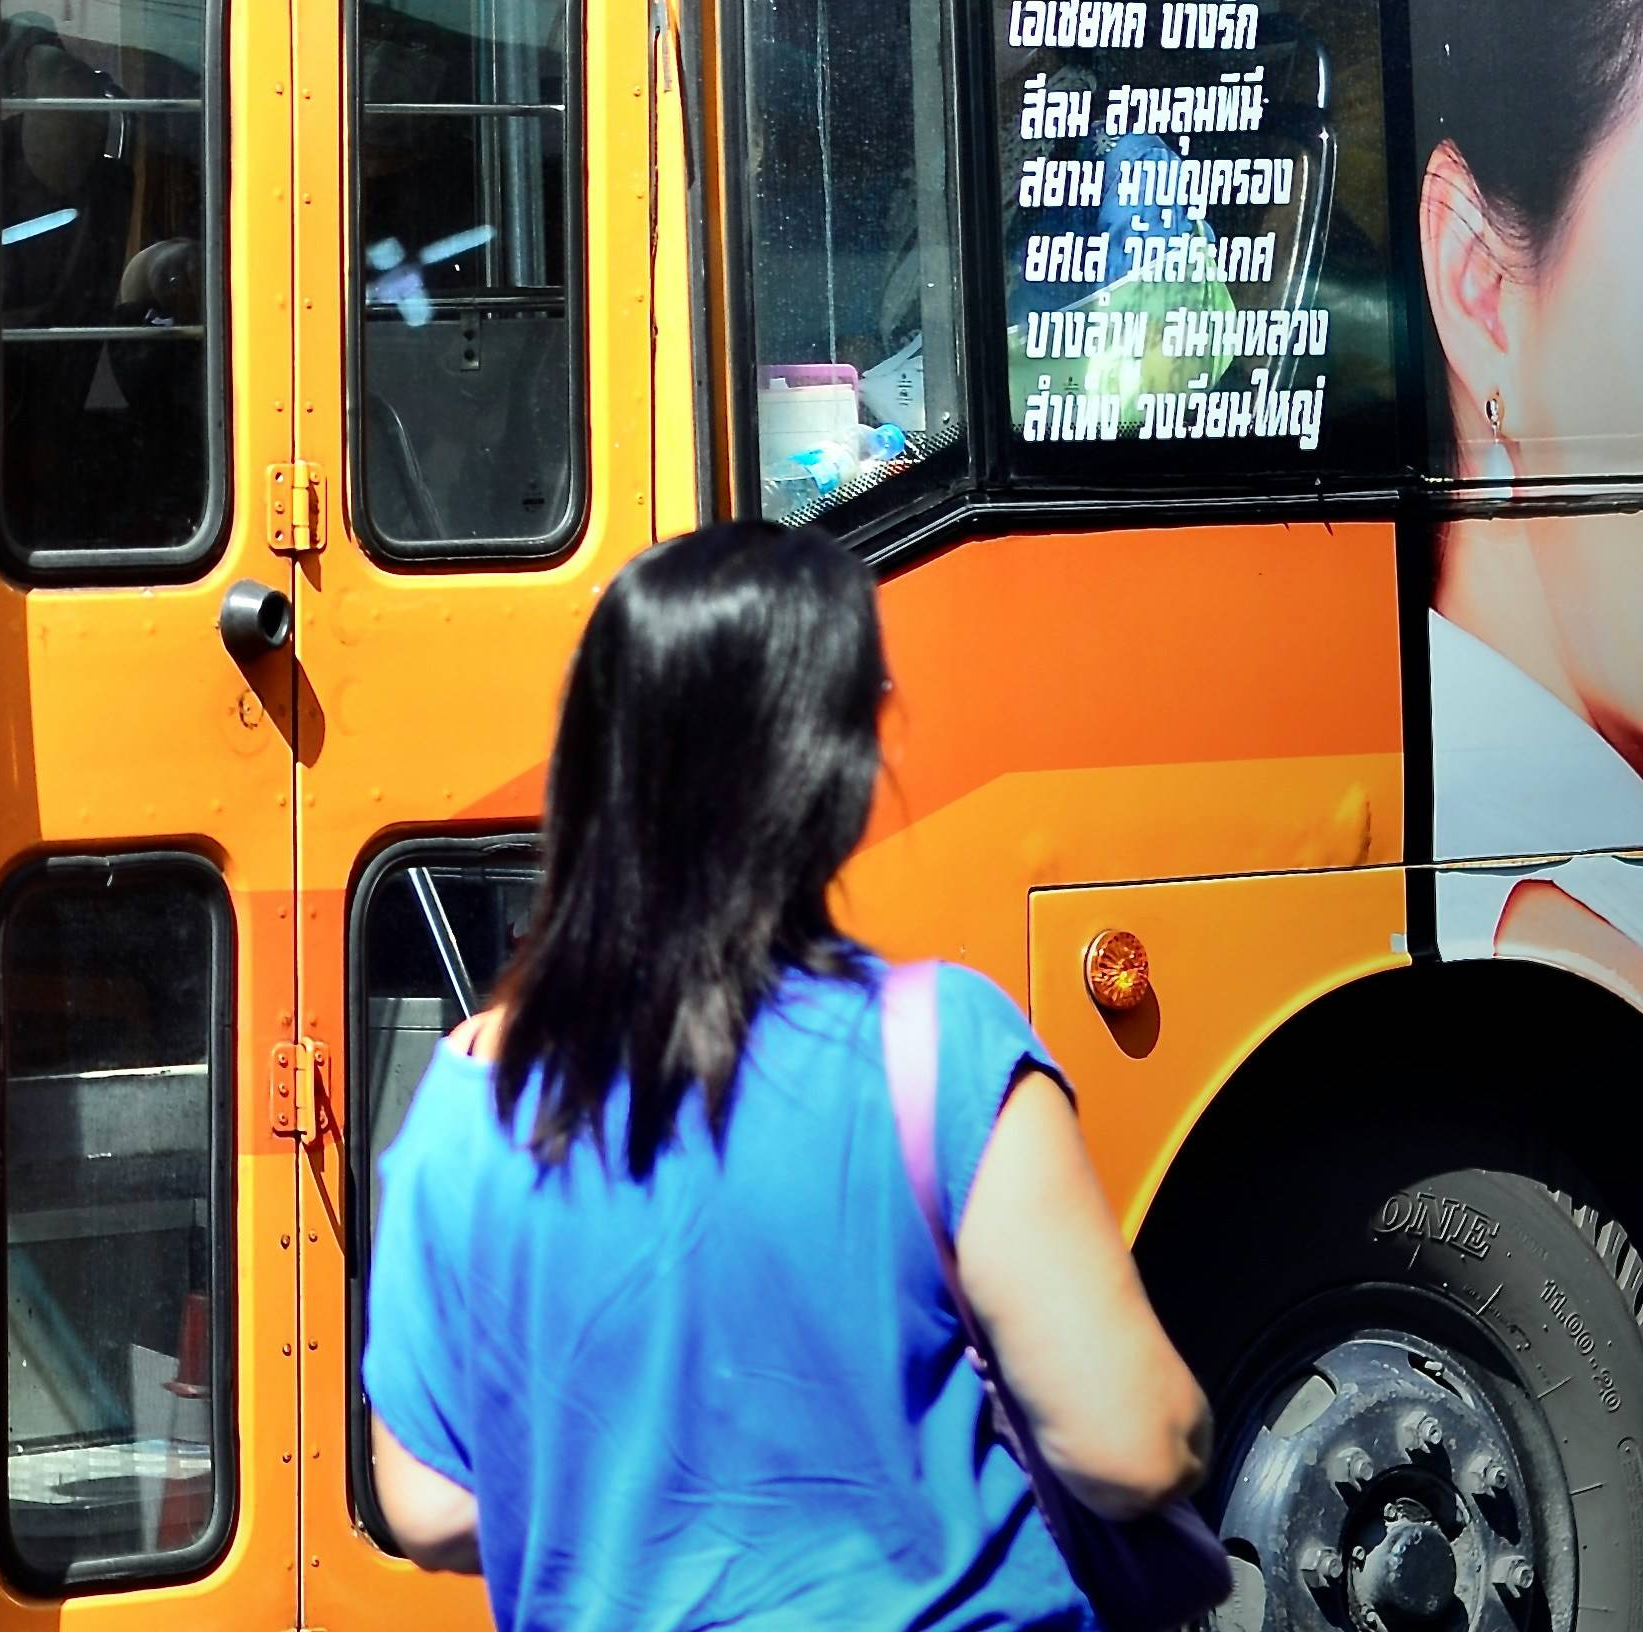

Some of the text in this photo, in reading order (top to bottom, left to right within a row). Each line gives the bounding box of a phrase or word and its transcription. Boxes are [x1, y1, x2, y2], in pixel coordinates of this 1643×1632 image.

[1020, 65, 1264, 155] สีลม สวนลุมพินี
[1019, 155, 1293, 228] สยาม มาบุญครอง
[1025, 215, 1276, 283] ยศเส วัดสระเกศ
[1161, 304, 1329, 358] สนามหลวง
